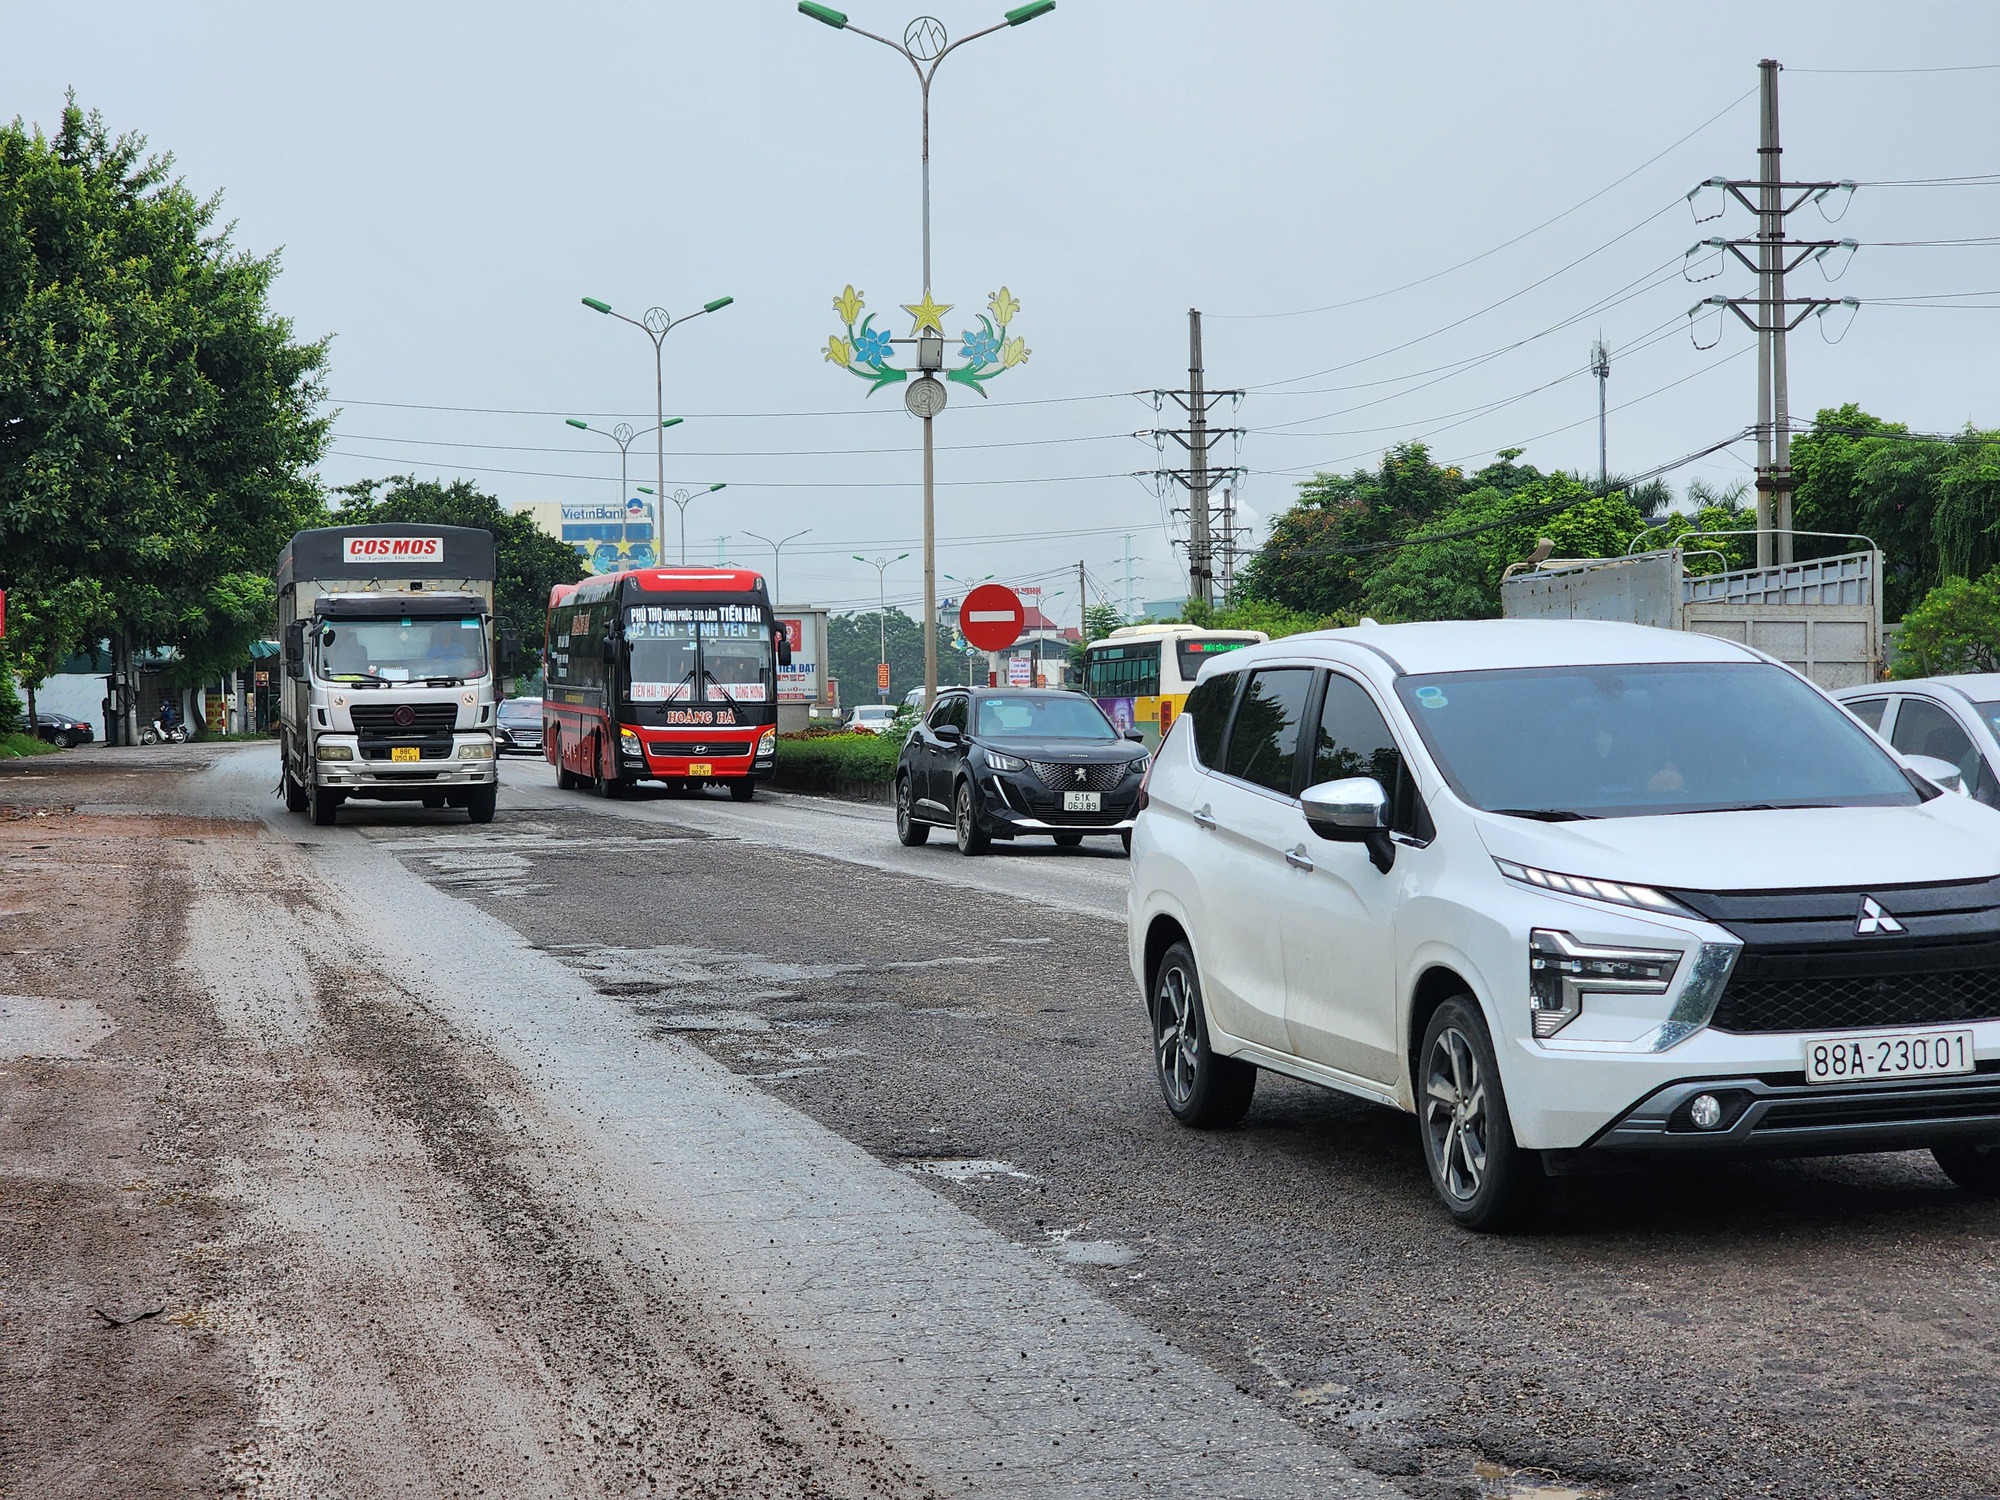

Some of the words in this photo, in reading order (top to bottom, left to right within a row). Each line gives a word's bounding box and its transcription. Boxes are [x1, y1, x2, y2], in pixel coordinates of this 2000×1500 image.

[350, 539, 437, 555] COSMOS
[631, 605, 646, 622] PHÚ
[648, 607, 662, 623] THỌ
[663, 608, 677, 622] VĨNH
[678, 608, 693, 622] PHÚC
[705, 608, 718, 622] LÂM
[687, 622, 719, 637] VNH
[667, 707, 713, 724] HOÀNG
[717, 707, 736, 724] HÀ
[1075, 793, 1090, 801] 61K
[1068, 802, 1097, 810] 063.89
[1814, 1035, 1965, 1077] 88A-230.01
